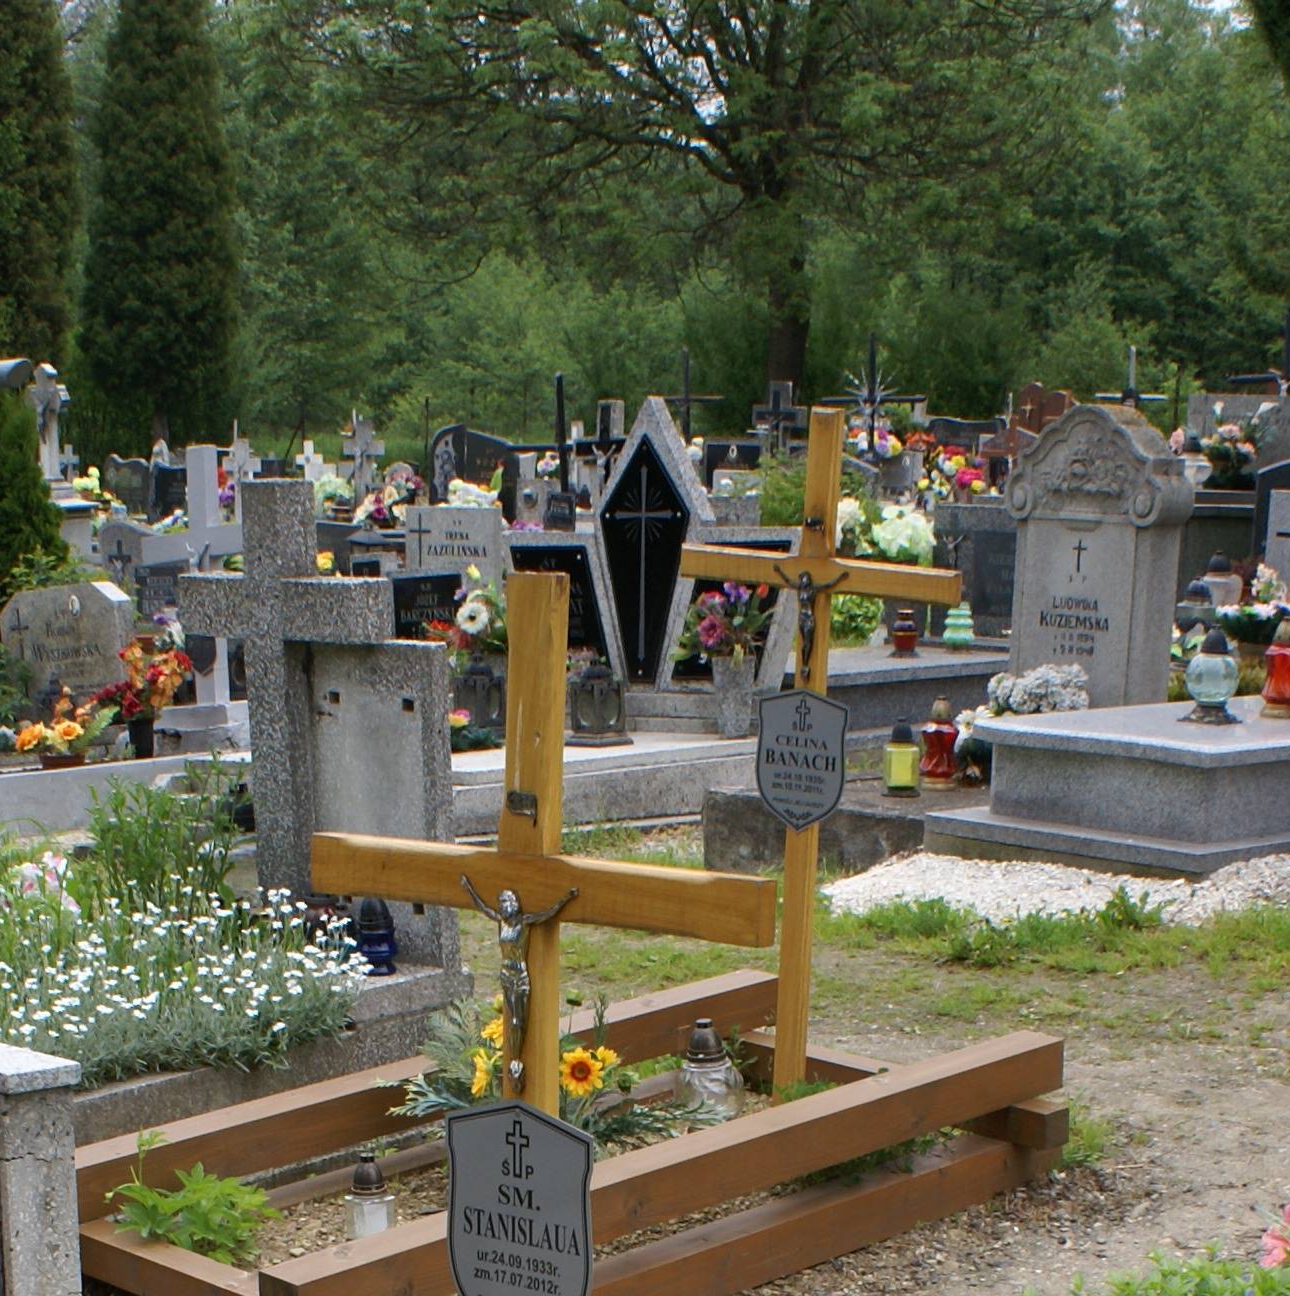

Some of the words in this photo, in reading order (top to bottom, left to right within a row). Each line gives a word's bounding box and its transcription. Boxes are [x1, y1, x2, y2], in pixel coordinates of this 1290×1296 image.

[1040, 610, 1109, 632] KUZIEMSKA
[775, 735, 828, 751] CELINA
[765, 749, 836, 772] BANACH
[525, 1165, 534, 1180] P
[498, 1184, 541, 1211] SM.
[463, 1206, 581, 1256] STANISLAUA
[476, 1250, 560, 1278] ur.24.09.1933r.
[474, 1266, 561, 1296] zm.17.07.2012r.
